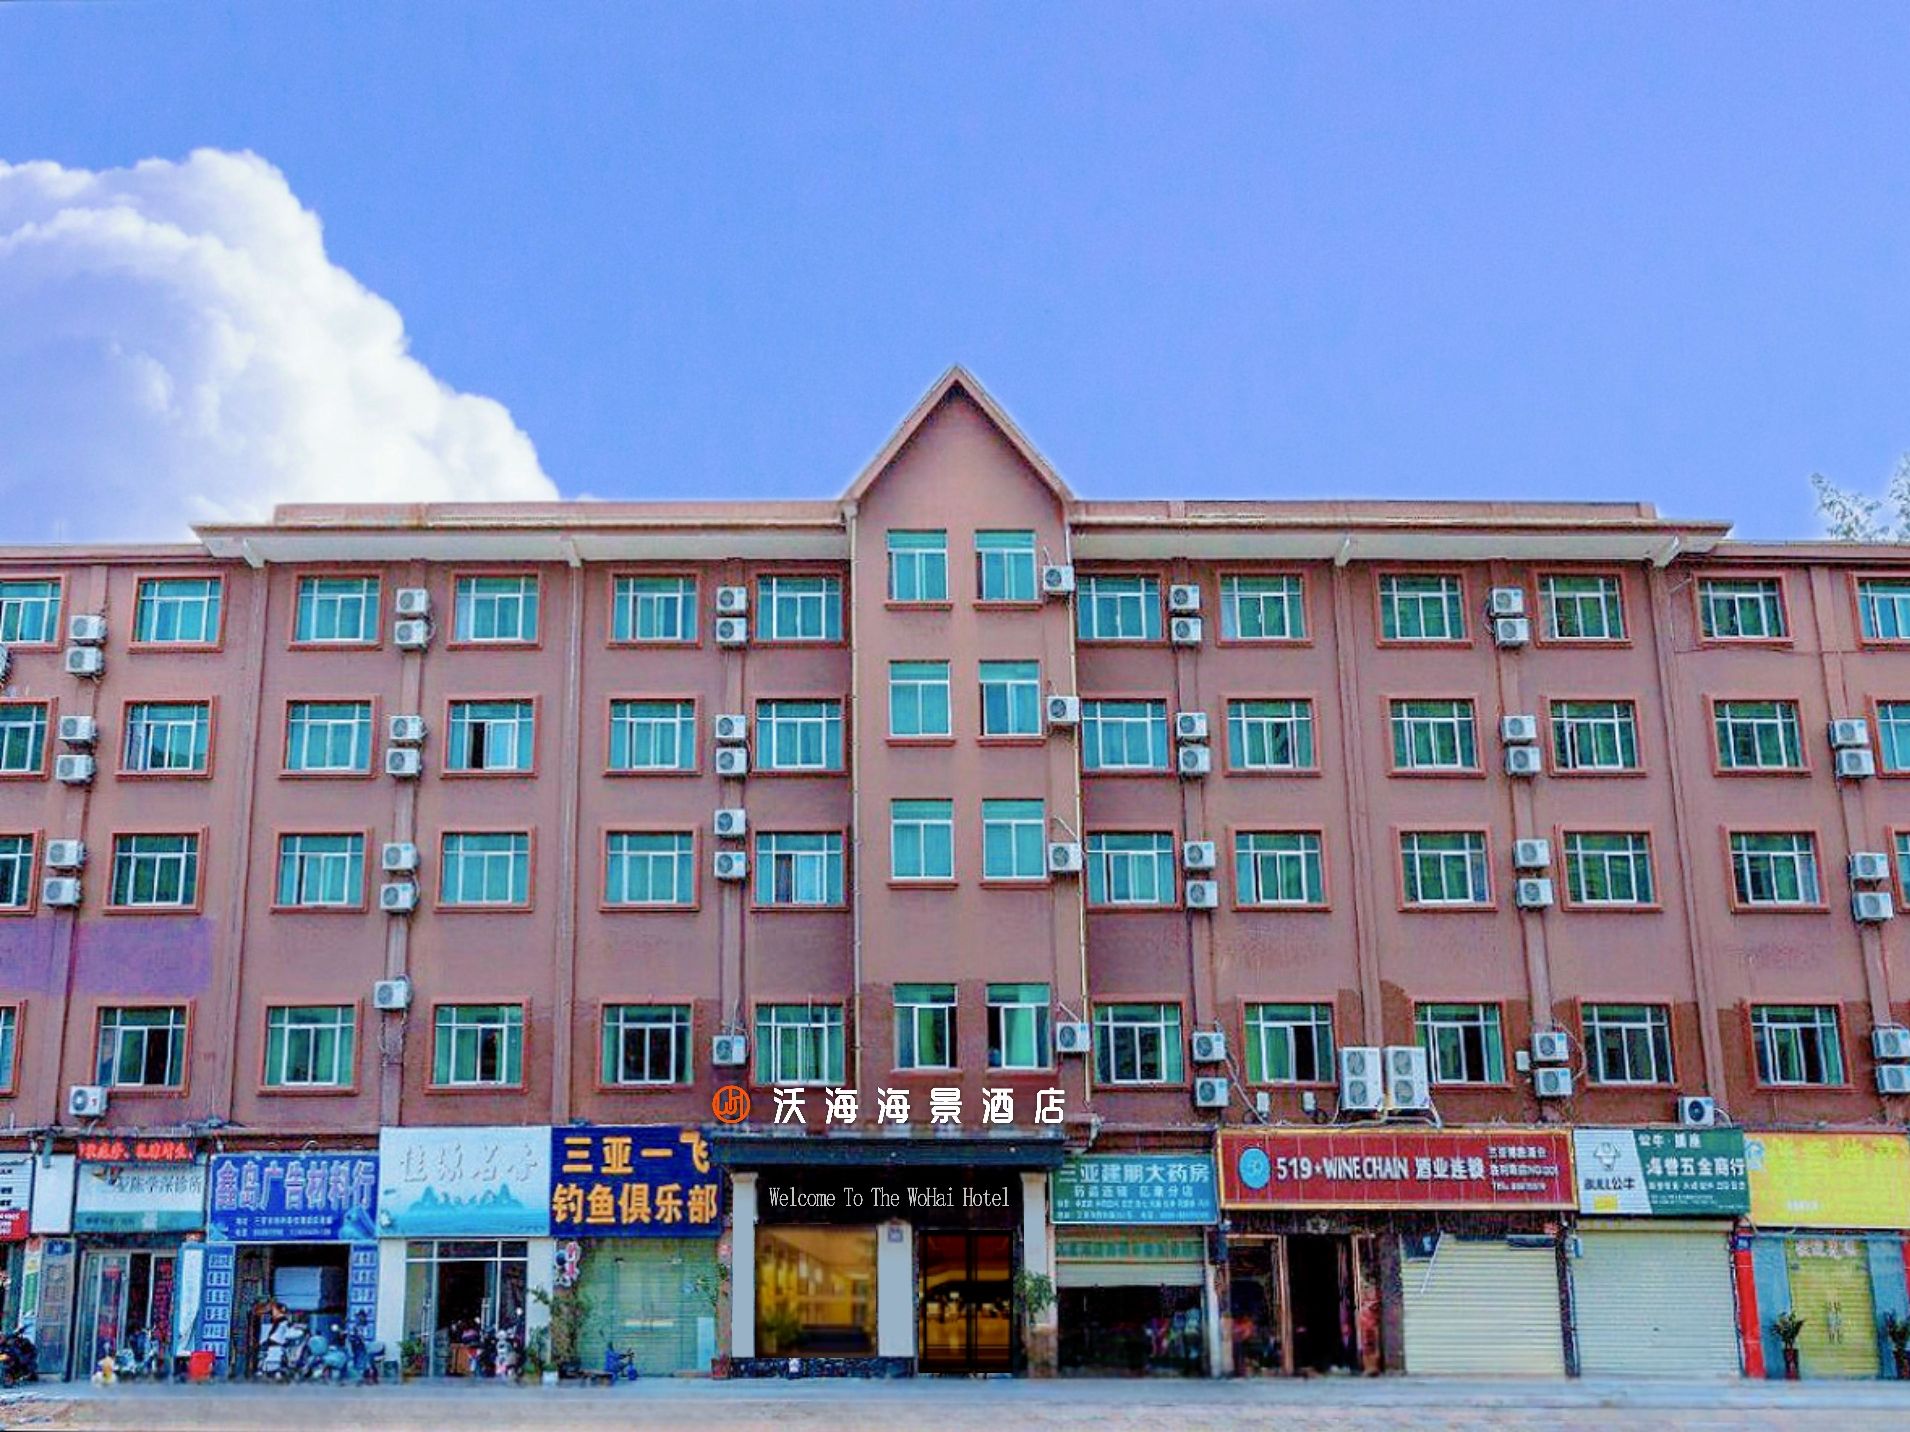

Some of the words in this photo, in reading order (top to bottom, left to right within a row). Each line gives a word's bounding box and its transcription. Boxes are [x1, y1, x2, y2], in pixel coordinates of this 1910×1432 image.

[773, 1087, 1066, 1124] 沃海海景酒店
[562, 1130, 710, 1174] 三亚一飞
[1276, 1156, 1312, 1181] 519
[1322, 1156, 1361, 1180] WINE
[1363, 1155, 1410, 1180] CHAIN
[551, 1183, 719, 1224] 钓鱼俱乐部
[769, 1187, 836, 1207] Welcome
[844, 1187, 863, 1207] To
[871, 1187, 900, 1207] The
[907, 1187, 955, 1207] WoHai
[963, 1187, 1010, 1207] Hotel
